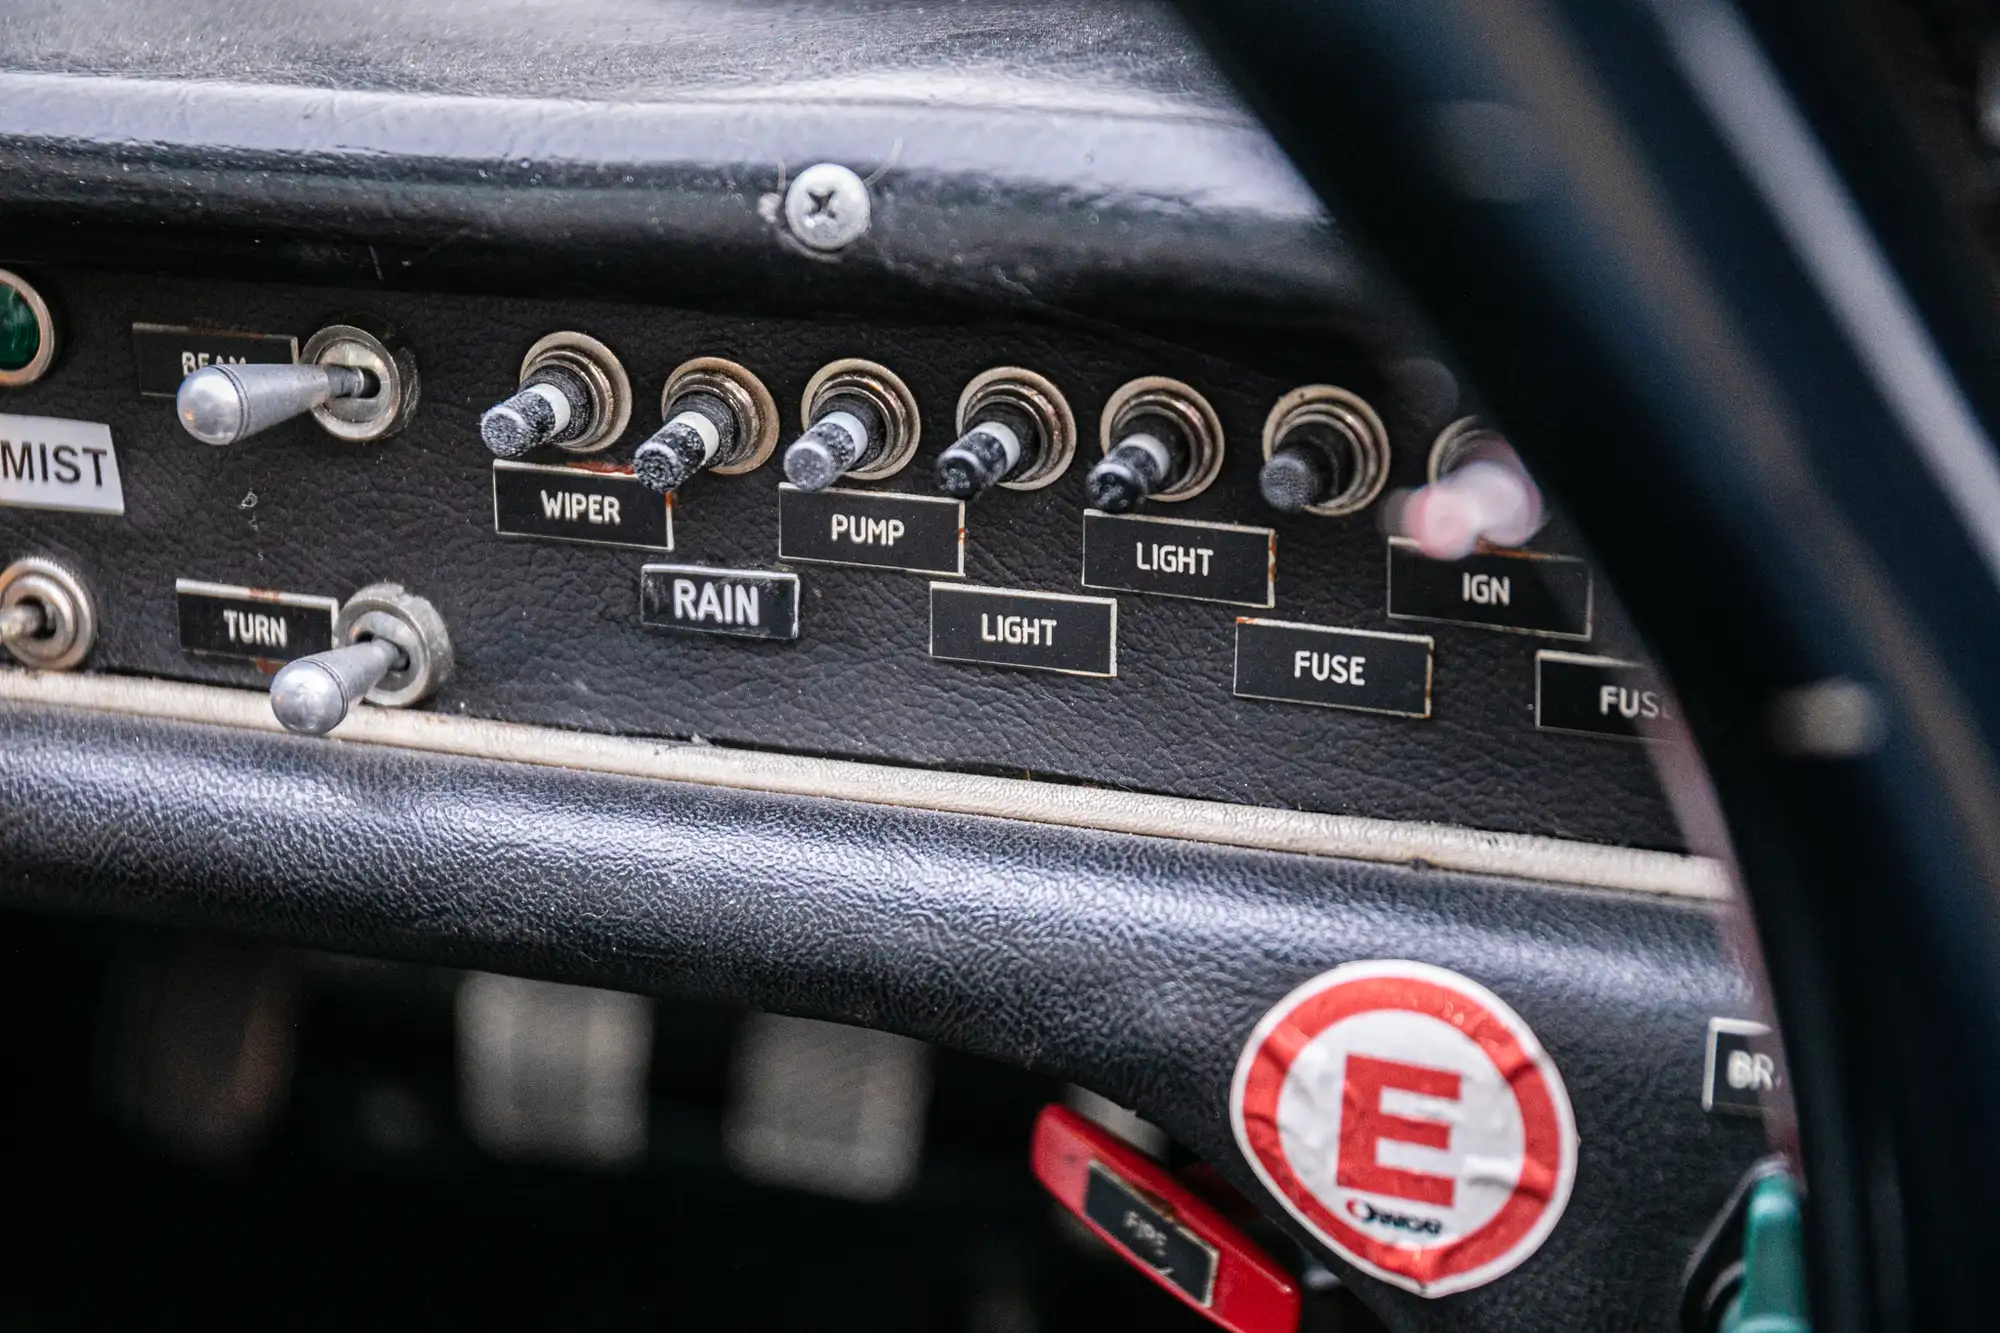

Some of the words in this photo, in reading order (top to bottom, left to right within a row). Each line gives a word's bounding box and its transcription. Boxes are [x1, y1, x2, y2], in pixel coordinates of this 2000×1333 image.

[1, 440, 107, 487] MIST
[540, 489, 621, 525] WIPER
[830, 513, 905, 546] PUMP
[1135, 540, 1214, 578] LIGHT
[671, 577, 762, 626] RAIN
[1462, 573, 1511, 606] IGN
[222, 609, 288, 648] TURN
[980, 612, 1058, 648] LIGHT
[1293, 650, 1367, 687] FUSE
[1337, 1055, 1462, 1206] E
